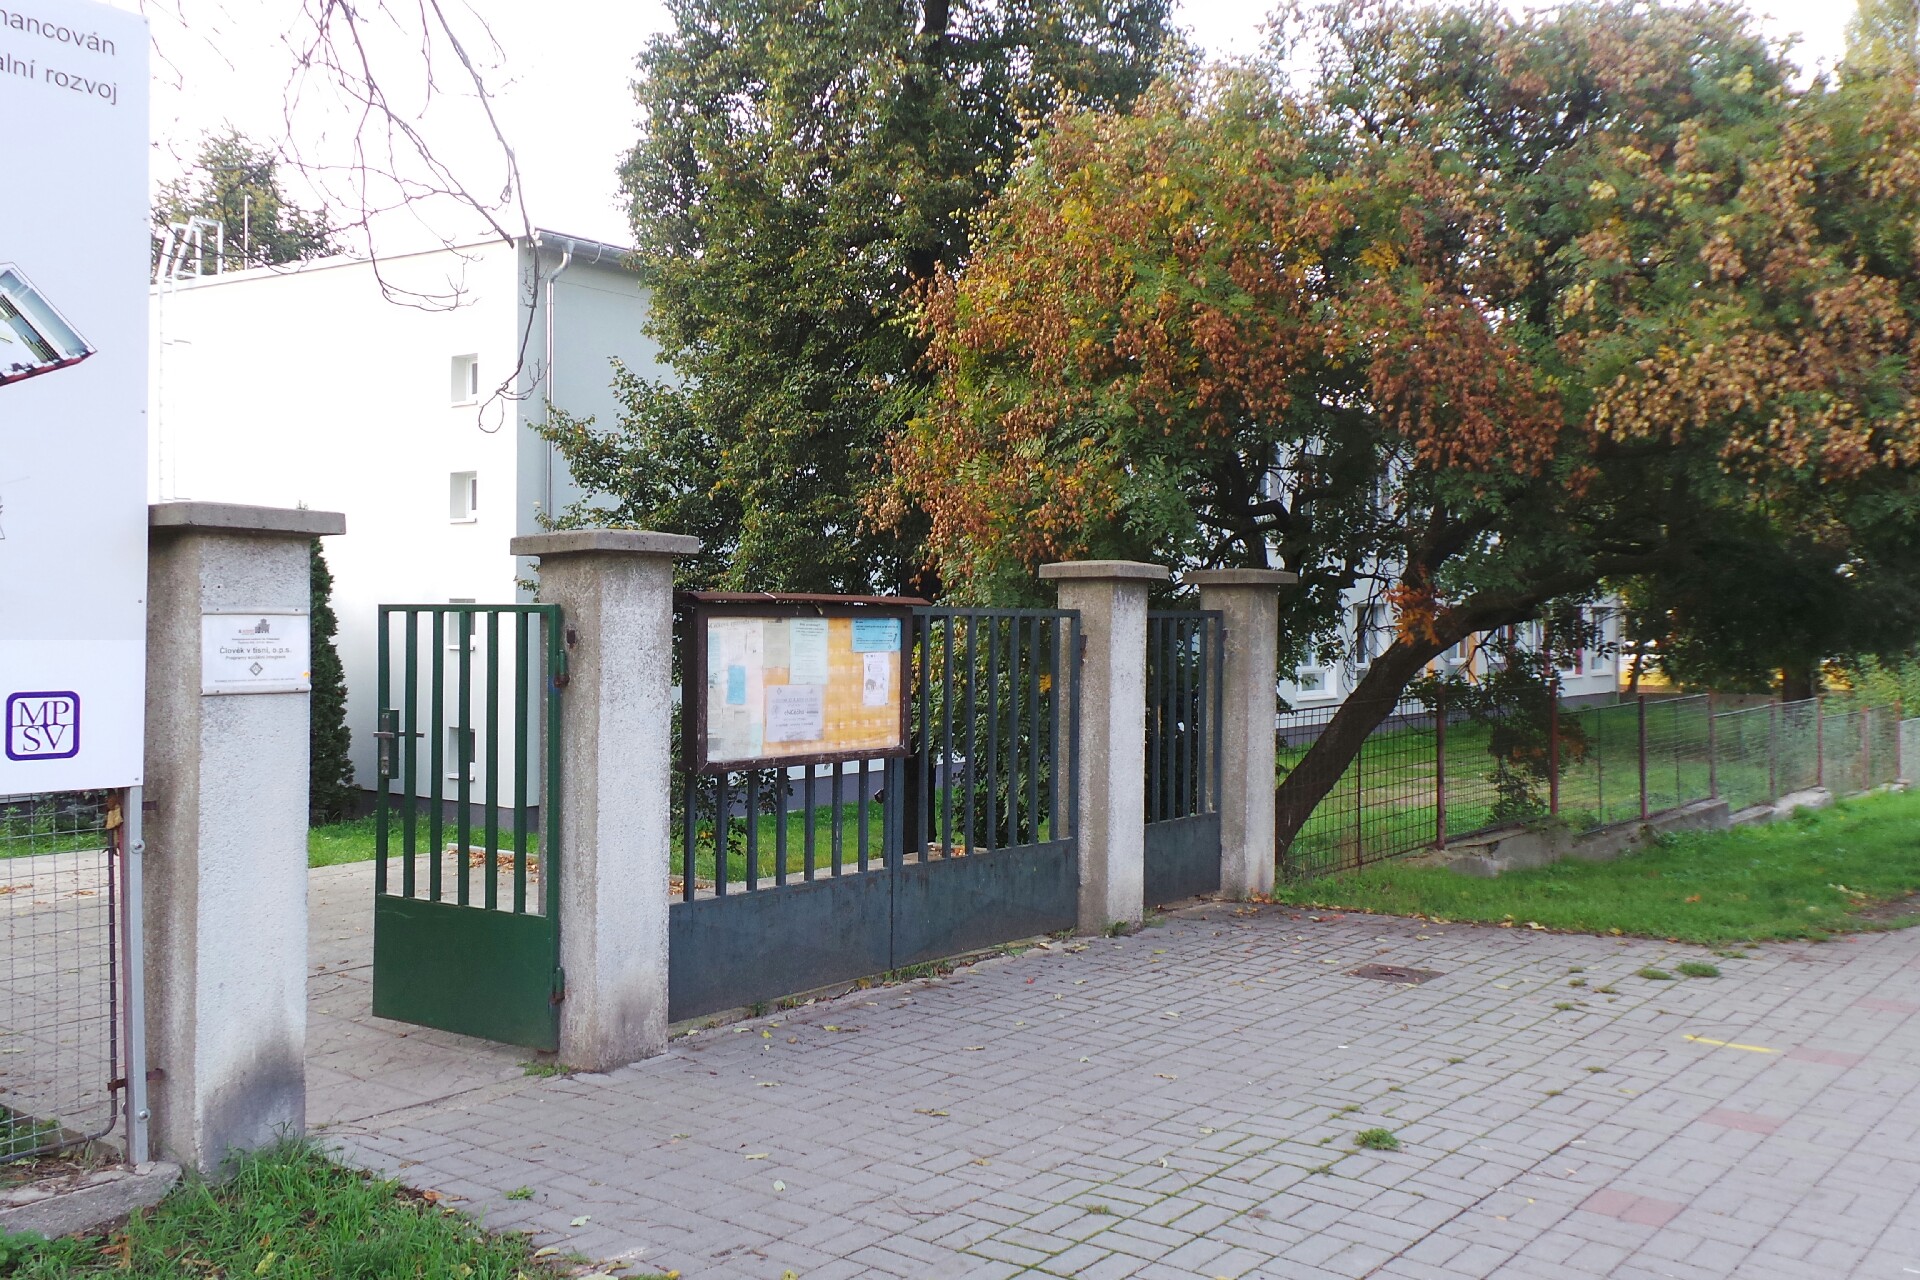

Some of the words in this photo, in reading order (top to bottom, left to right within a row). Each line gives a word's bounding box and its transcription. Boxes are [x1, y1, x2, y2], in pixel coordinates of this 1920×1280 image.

[46, 68, 117, 105] rozvoj
[220, 646, 244, 654] Člověk
[17, 701, 70, 726] MP
[23, 726, 66, 751] SV
